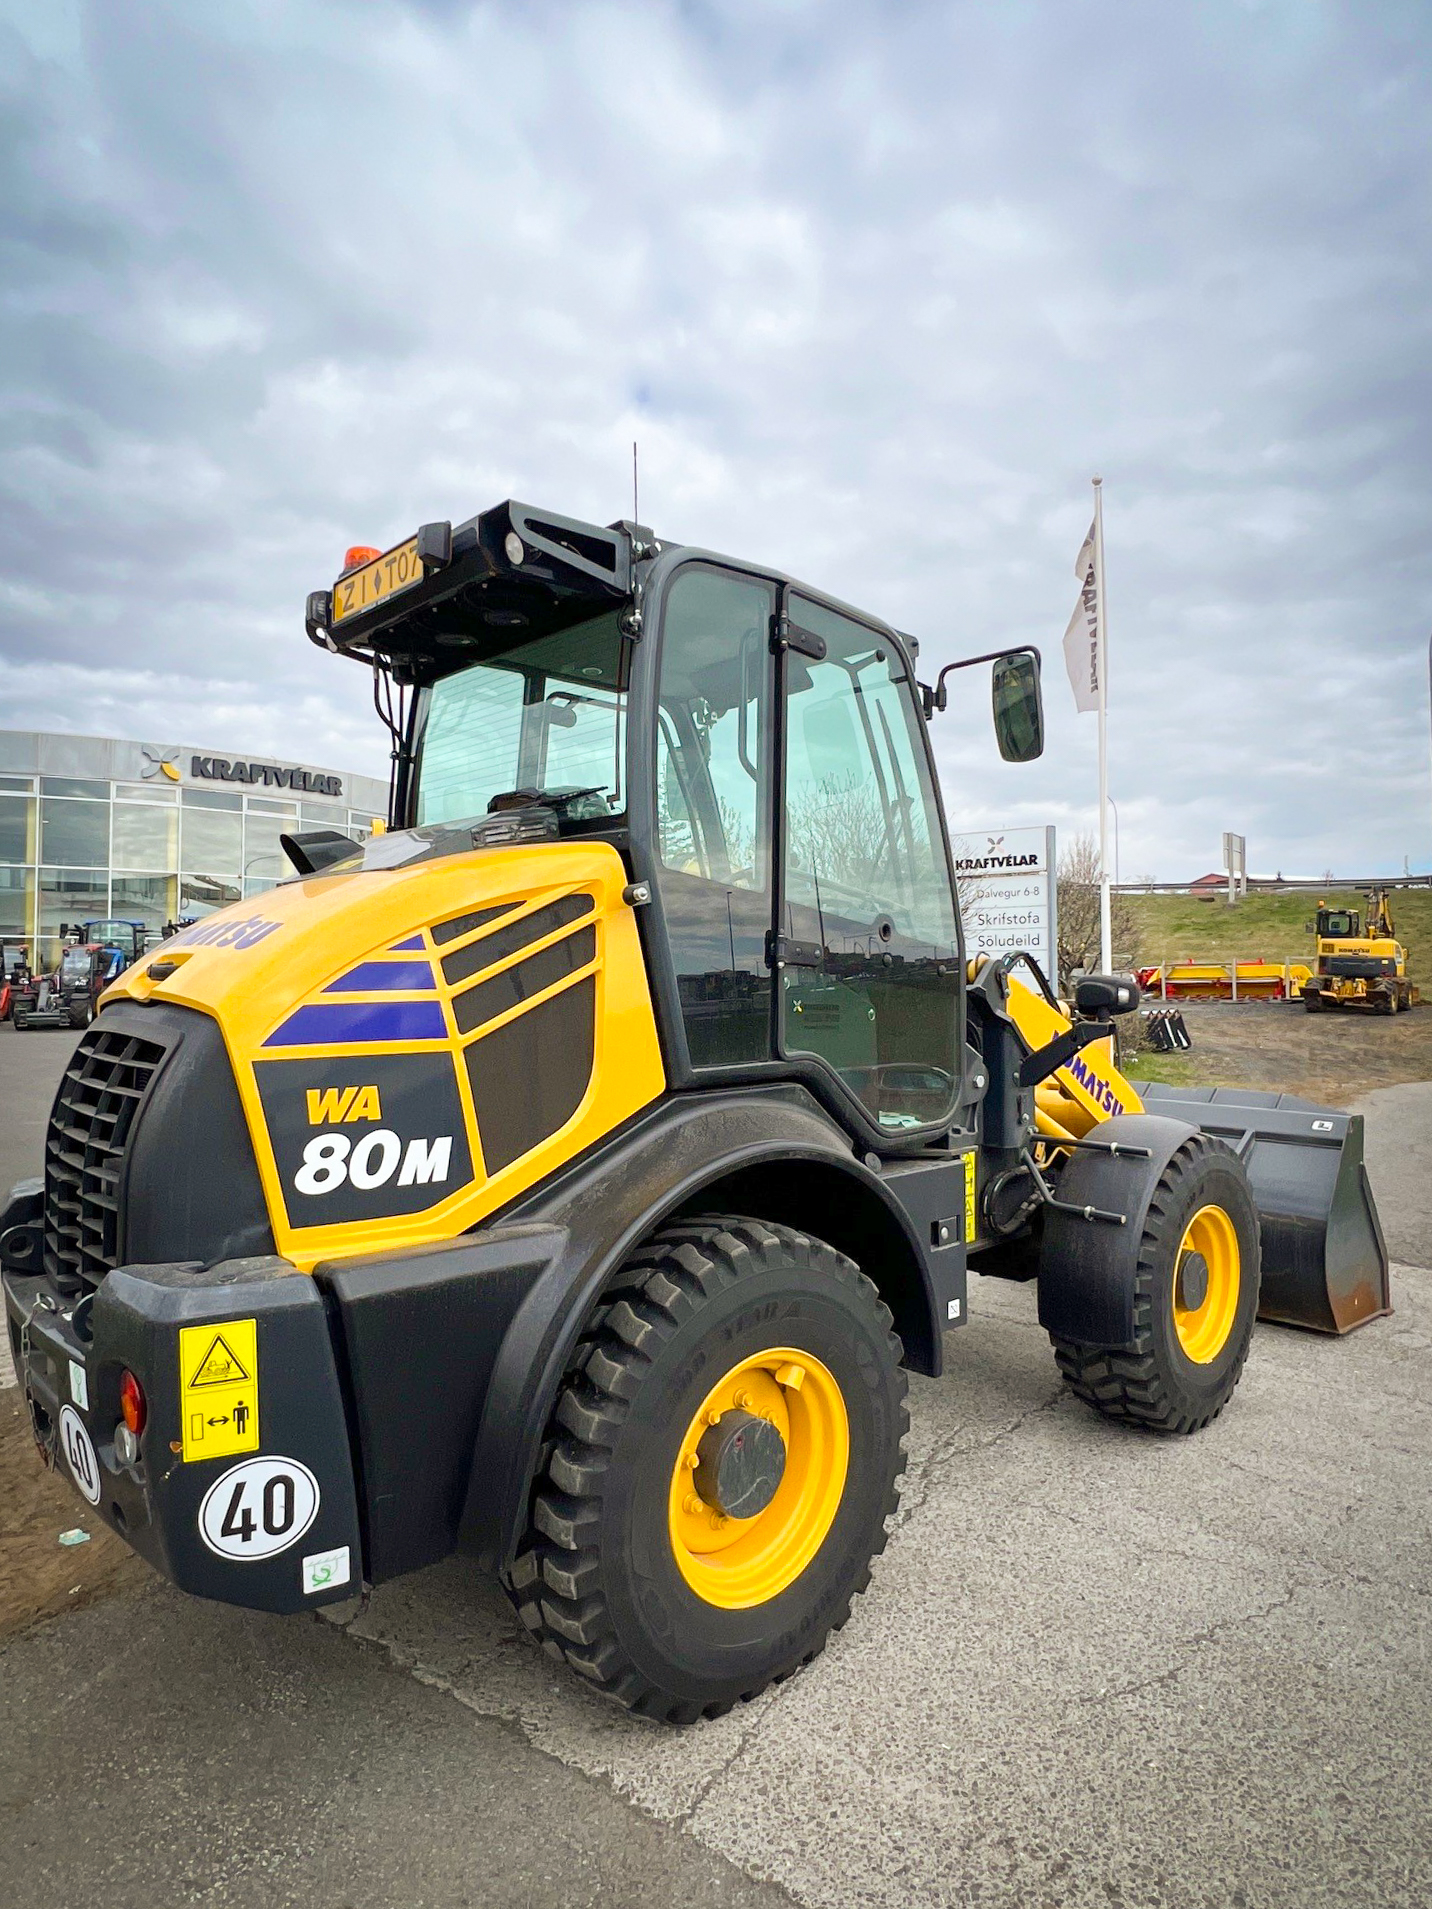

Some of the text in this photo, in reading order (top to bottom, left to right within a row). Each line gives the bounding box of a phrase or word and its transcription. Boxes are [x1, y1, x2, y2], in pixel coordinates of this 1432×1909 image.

[191, 755, 343, 797] KRAFTVÉLAR
[955, 853, 1038, 871] KRAFTVÉLAR
[1023, 885, 1040, 896] 6-8
[158, 913, 285, 950] MATSU
[977, 911, 1040, 927] Skrifstofa
[978, 933, 1040, 948] Söludeild
[1052, 1030, 1124, 1117] MATSU
[306, 1085, 383, 1125] WA
[293, 1128, 453, 1196] 80M
[65, 1421, 95, 1493] 40
[220, 1473, 295, 1543] 40
